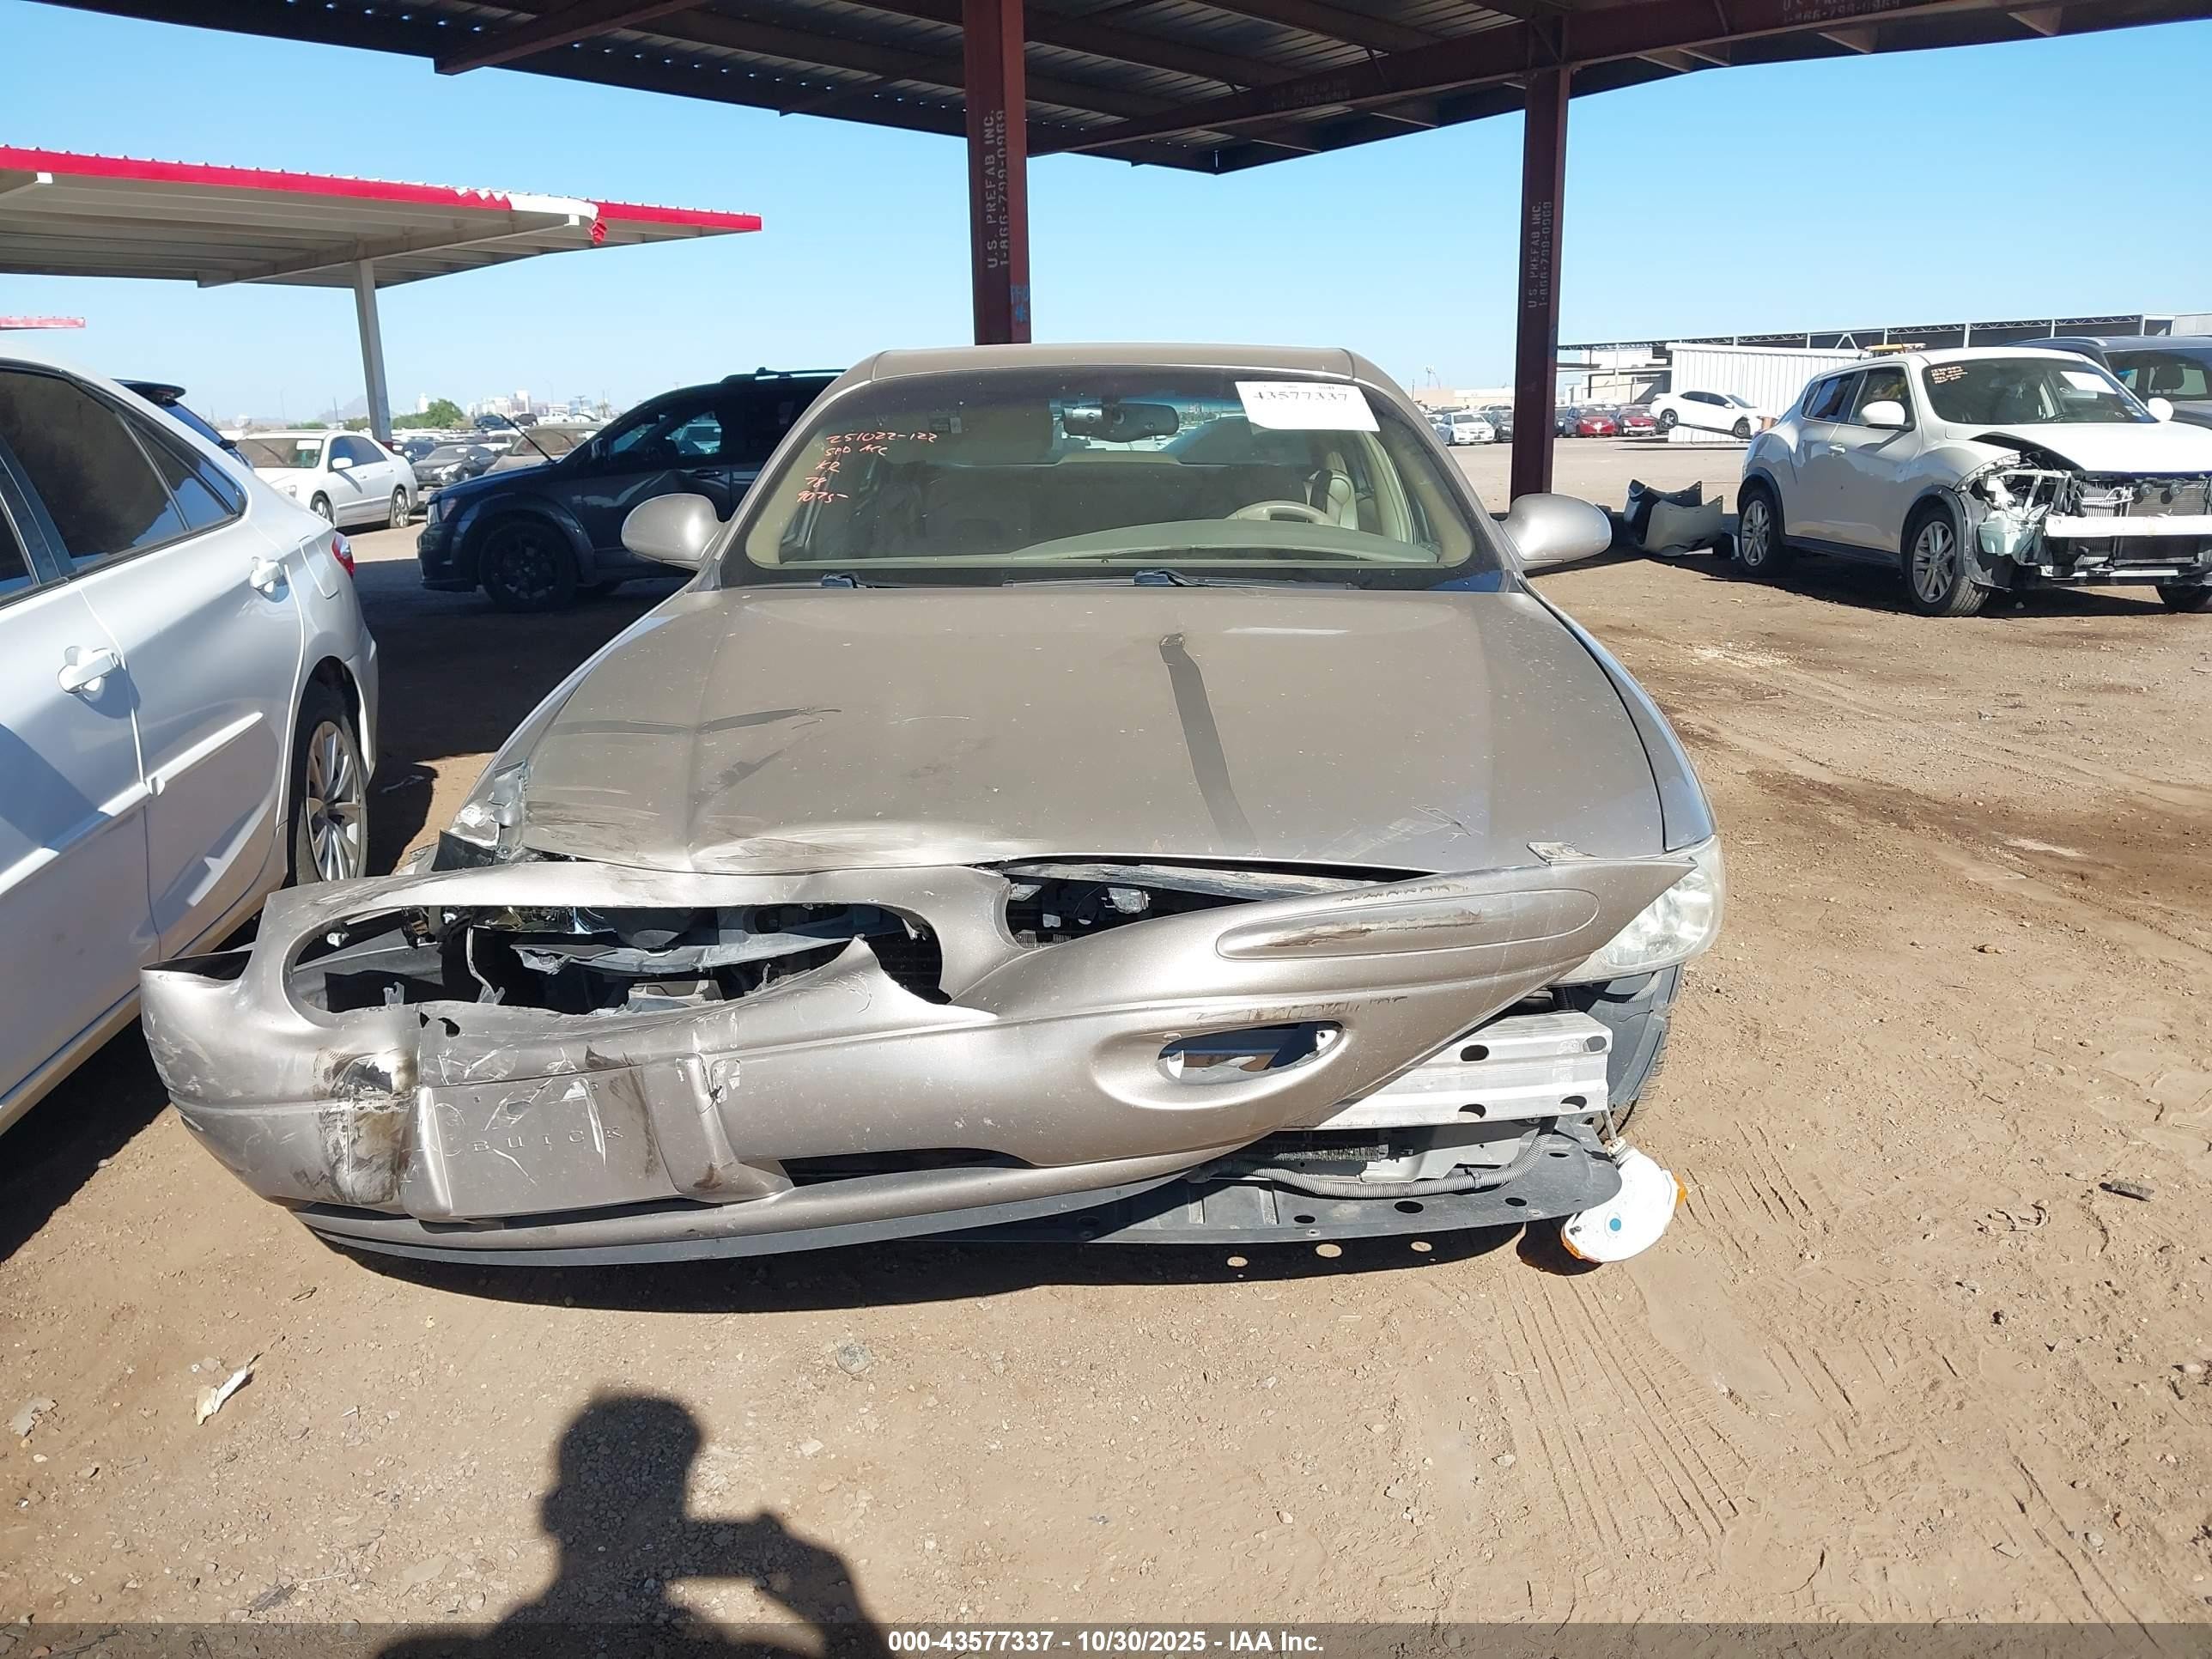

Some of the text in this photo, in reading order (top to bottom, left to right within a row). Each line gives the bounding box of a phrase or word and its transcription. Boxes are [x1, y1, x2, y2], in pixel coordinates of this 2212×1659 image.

[983, 109, 998, 269] U.S. PREFAB INC.
[472, 1126, 623, 1152] BUICK
